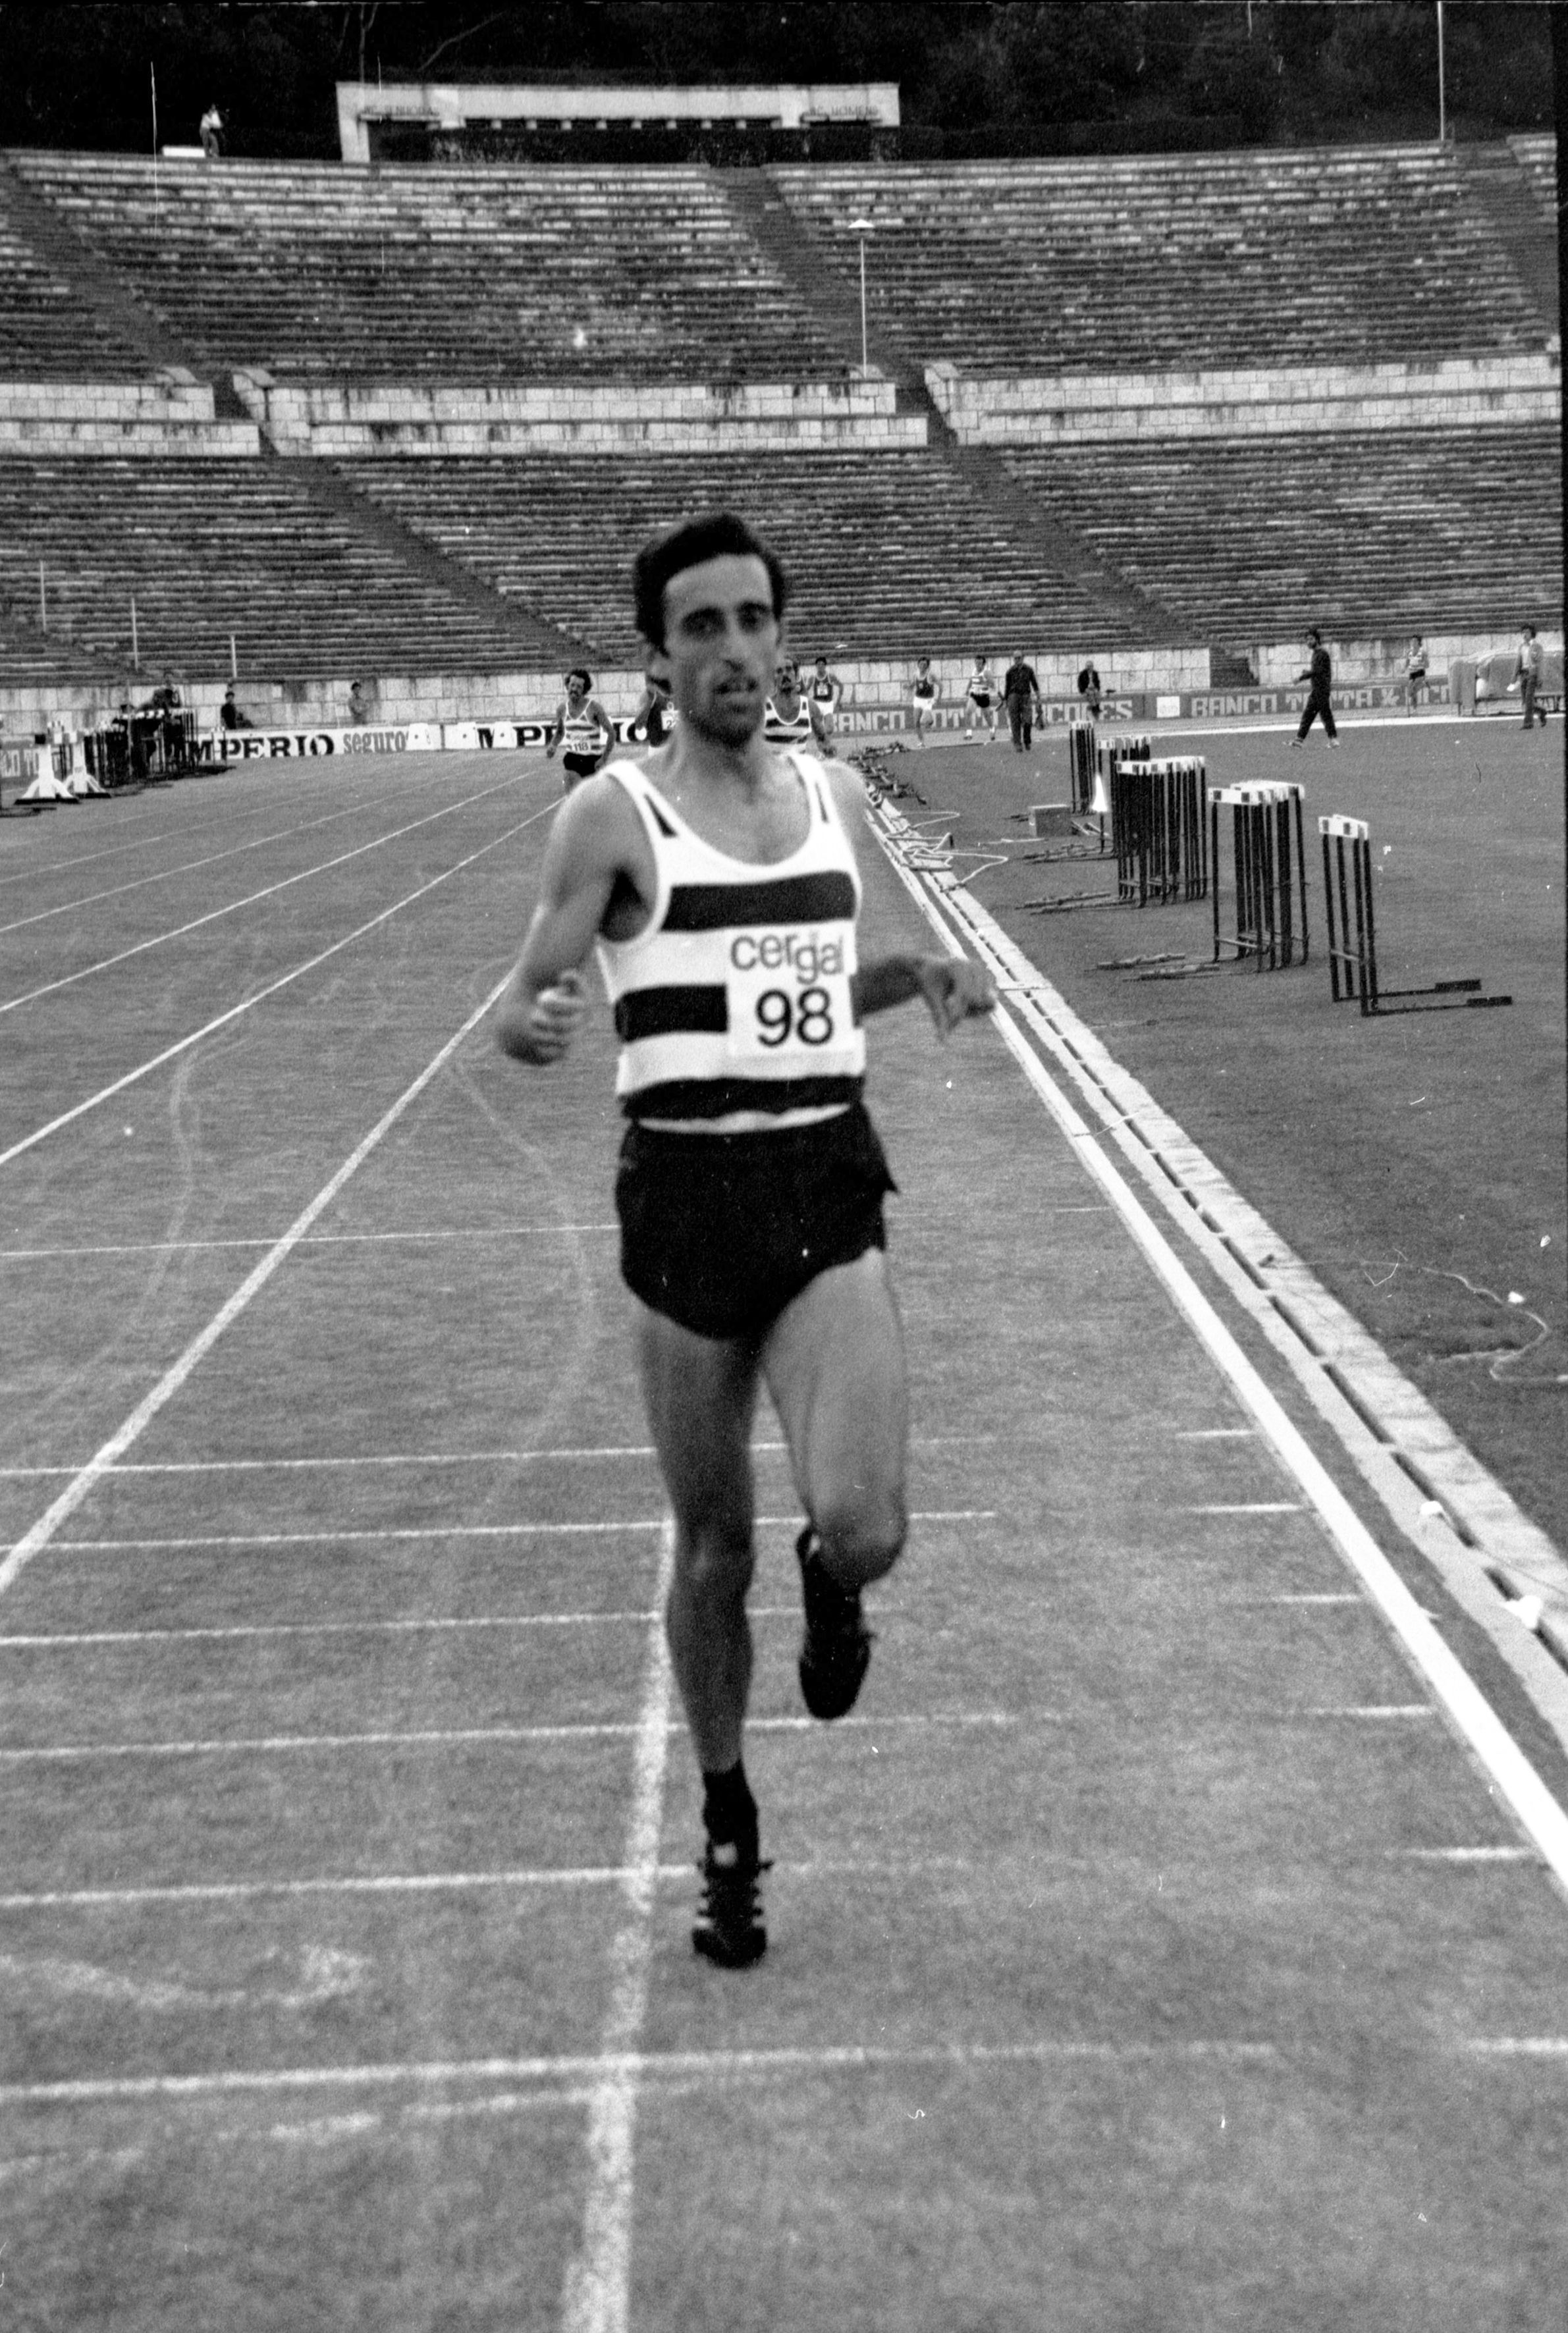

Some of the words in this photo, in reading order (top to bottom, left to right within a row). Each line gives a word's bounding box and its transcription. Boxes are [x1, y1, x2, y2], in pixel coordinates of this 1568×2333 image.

[1191, 693, 1277, 716] BANCO
[1285, 689, 1373, 712] TTA
[832, 711, 906, 732] ANCO
[188, 734, 335, 761] MPERIO
[755, 988, 834, 1048] 98
